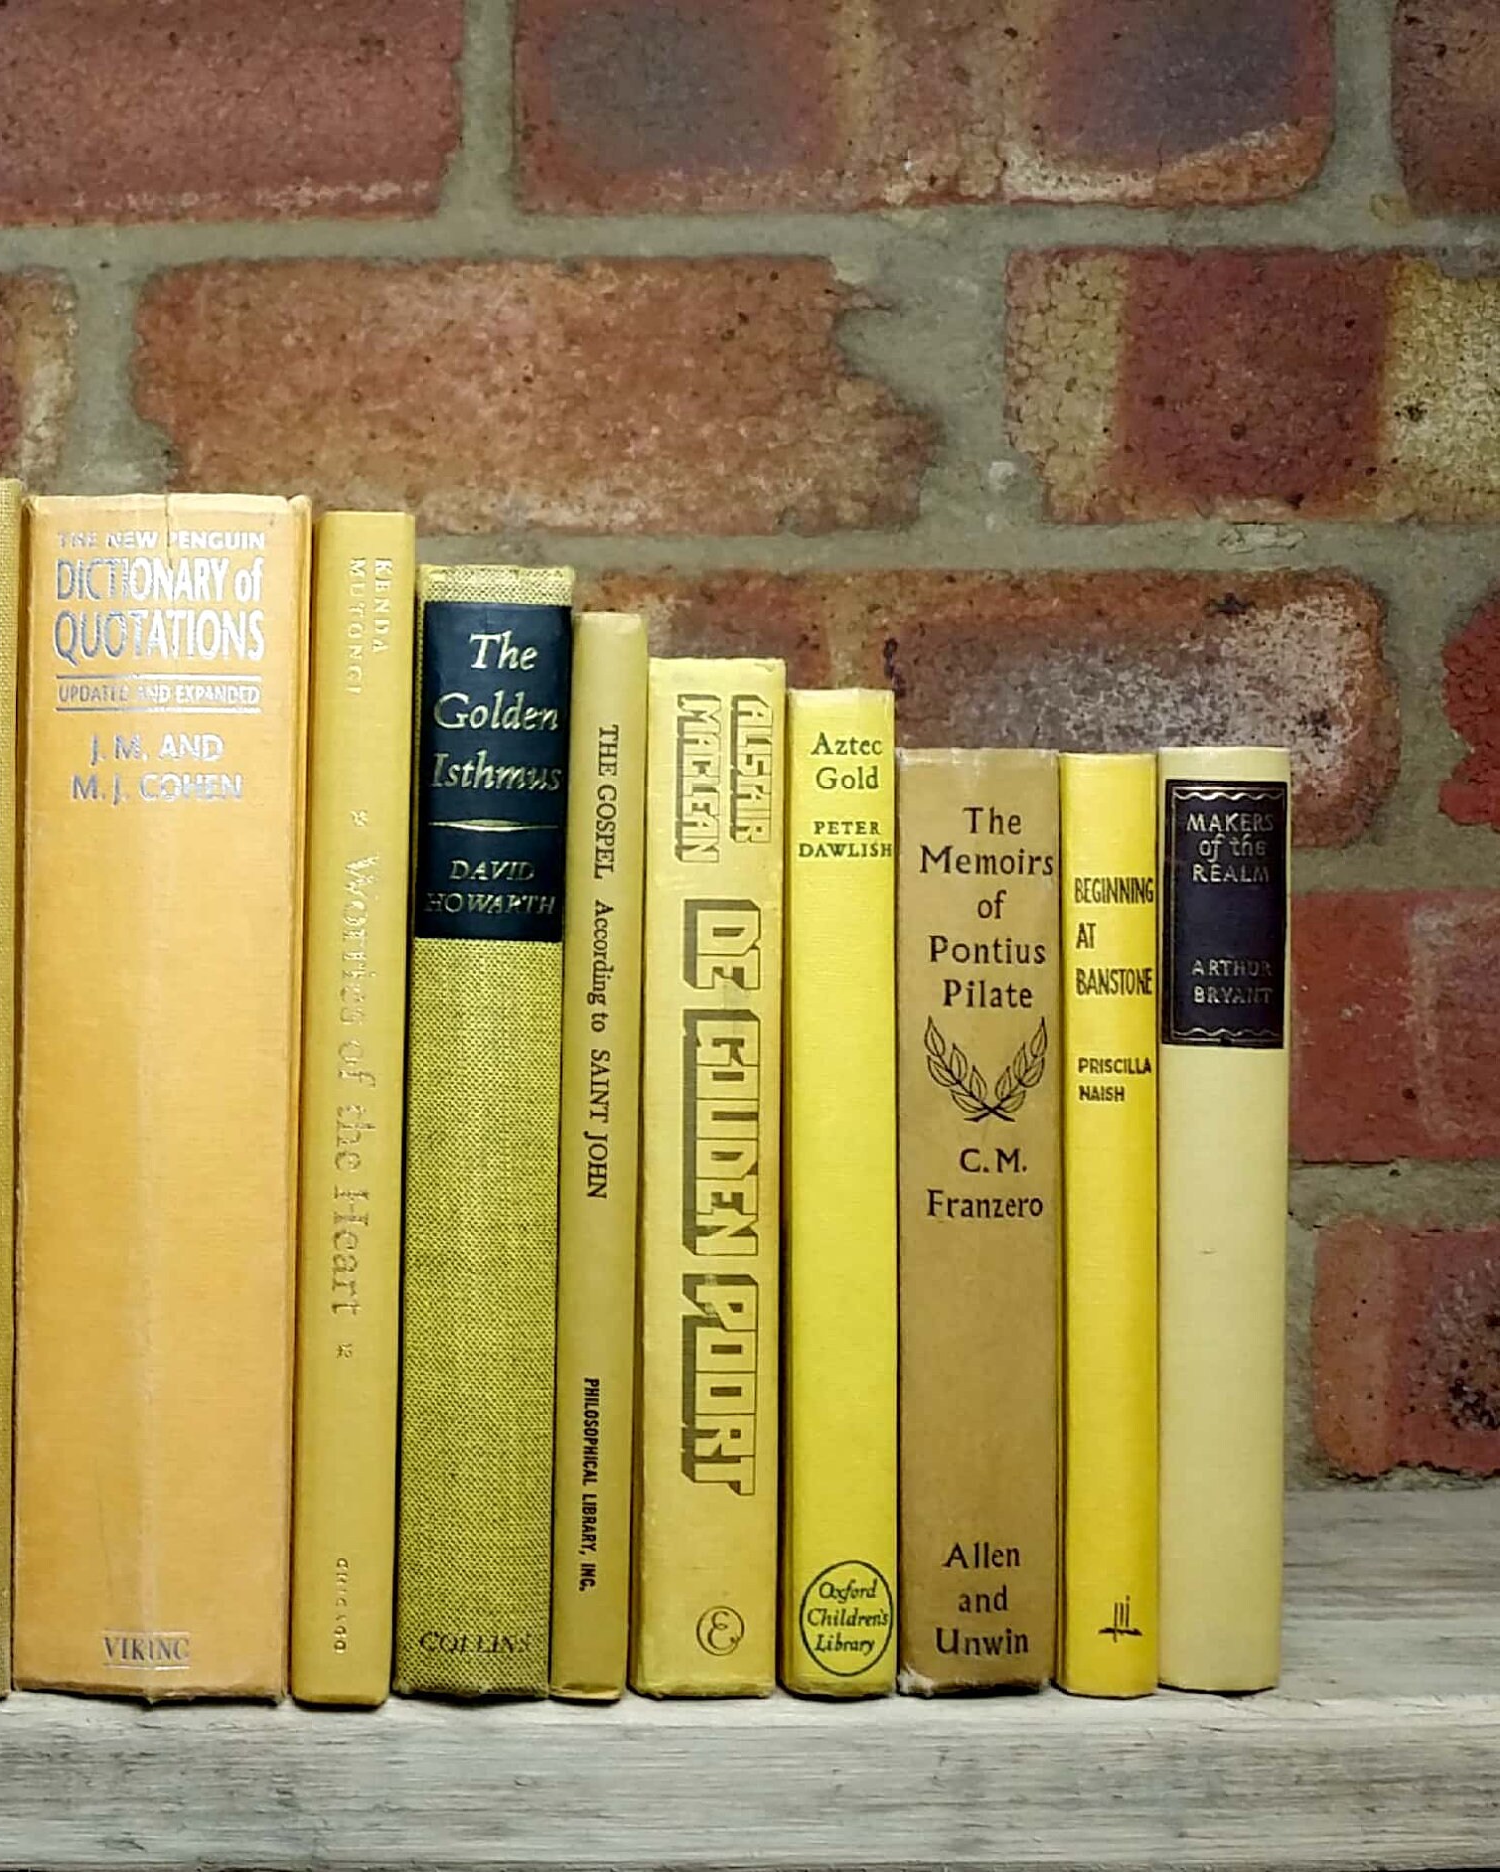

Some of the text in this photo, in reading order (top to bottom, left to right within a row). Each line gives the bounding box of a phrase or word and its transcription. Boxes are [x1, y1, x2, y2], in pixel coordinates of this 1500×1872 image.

[106, 531, 158, 549] NEW
[168, 531, 265, 550] PENGUIN
[56, 556, 264, 602] DICTIONARY of
[371, 558, 393, 654] KENDA
[54, 609, 265, 667] QUOTATIONS
[469, 630, 539, 671] The
[58, 685, 261, 705] UPDATED AND EXPANDED
[433, 690, 558, 732] Golden
[90, 734, 224, 766] J. M. AND
[811, 732, 883, 757] Aztec
[430, 750, 561, 791] Isthmus
[673, 692, 722, 863] MACLEAN
[730, 694, 773, 844] ALISTAIR
[816, 766, 879, 791] Gold
[71, 773, 243, 805] M. J. COHEN
[813, 819, 881, 836] PETER
[963, 807, 1022, 835] The
[1186, 813, 1273, 833] MAKERS
[799, 841, 893, 858] DAWLISH
[921, 844, 1053, 876] Memoirs
[1198, 833, 1266, 861] of the
[450, 860, 534, 881] DAVID
[1192, 864, 1270, 883] REALM
[424, 893, 556, 915] HOWARTH
[1074, 877, 1154, 904] BEGINNING
[978, 890, 1007, 920] of
[929, 935, 1046, 964] Pontius
[1076, 922, 1096, 949] AT
[585, 724, 619, 1199] THE GOSPEL According to SAINT JOHN
[1191, 959, 1272, 978] ARTHUR
[942, 979, 1033, 1009] Pilate
[1076, 968, 1153, 996] BANSTONE
[1193, 986, 1272, 1004] BRYANT
[1078, 1057, 1151, 1075] PRISCILLA
[330, 855, 381, 1317] Worries of the Heart
[1079, 1086, 1125, 1102] NAISH
[959, 1148, 1028, 1173] C. M.
[679, 899, 761, 1496] DE GOUDEN POORT
[927, 1189, 1044, 1218] Franzero
[578, 1377, 600, 1593] PHILOSOPHICAL LIBRARY, INC.
[941, 1542, 1021, 1568] Allen
[819, 1578, 878, 1601] Oxford
[958, 1585, 1008, 1613] and
[807, 1606, 889, 1628] Children's
[103, 1635, 190, 1664] VIKING
[420, 1631, 533, 1654] COLLINS
[814, 1634, 876, 1656] Library
[935, 1627, 1029, 1657] Unwin
